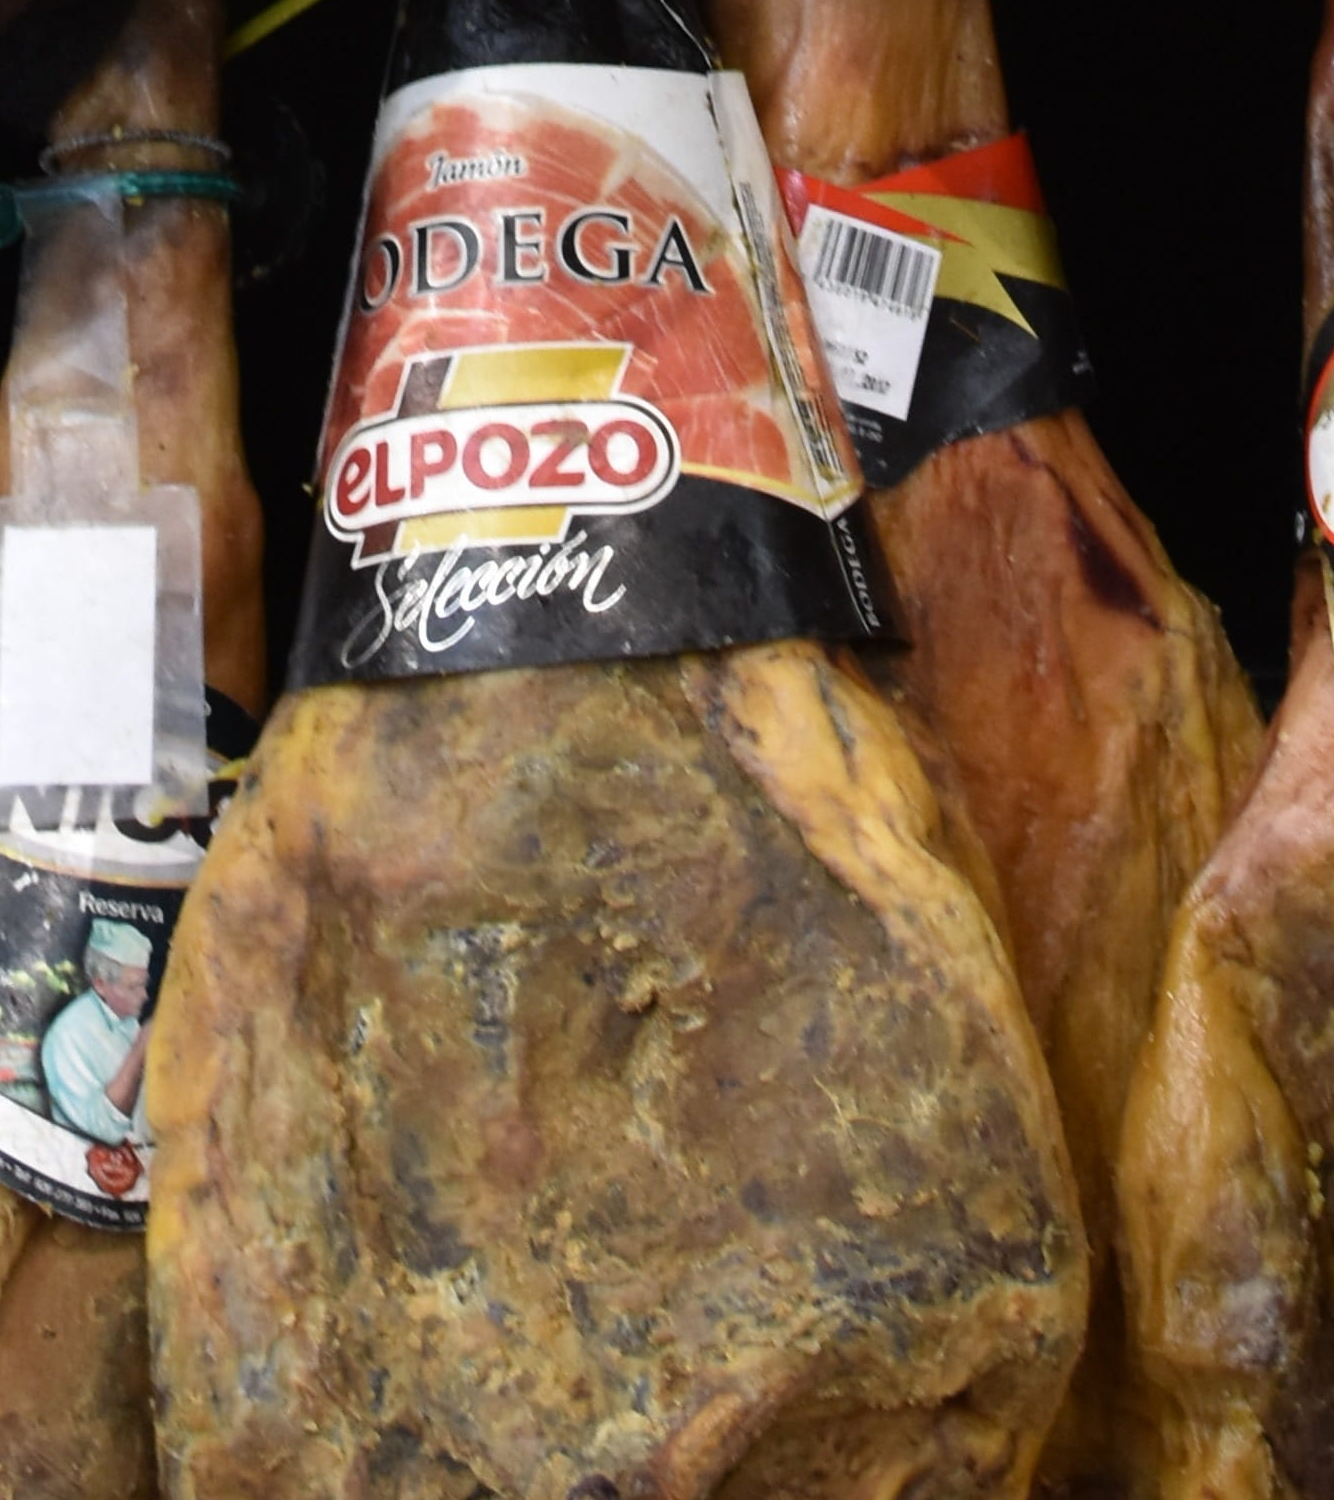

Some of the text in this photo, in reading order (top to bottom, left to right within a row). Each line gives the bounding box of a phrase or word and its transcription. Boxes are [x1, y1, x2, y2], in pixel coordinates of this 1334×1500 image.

[424, 147, 529, 193] Jamón
[358, 209, 714, 315] ODEGA
[341, 529, 625, 670] Selección
[78, 890, 164, 925] Reserva
